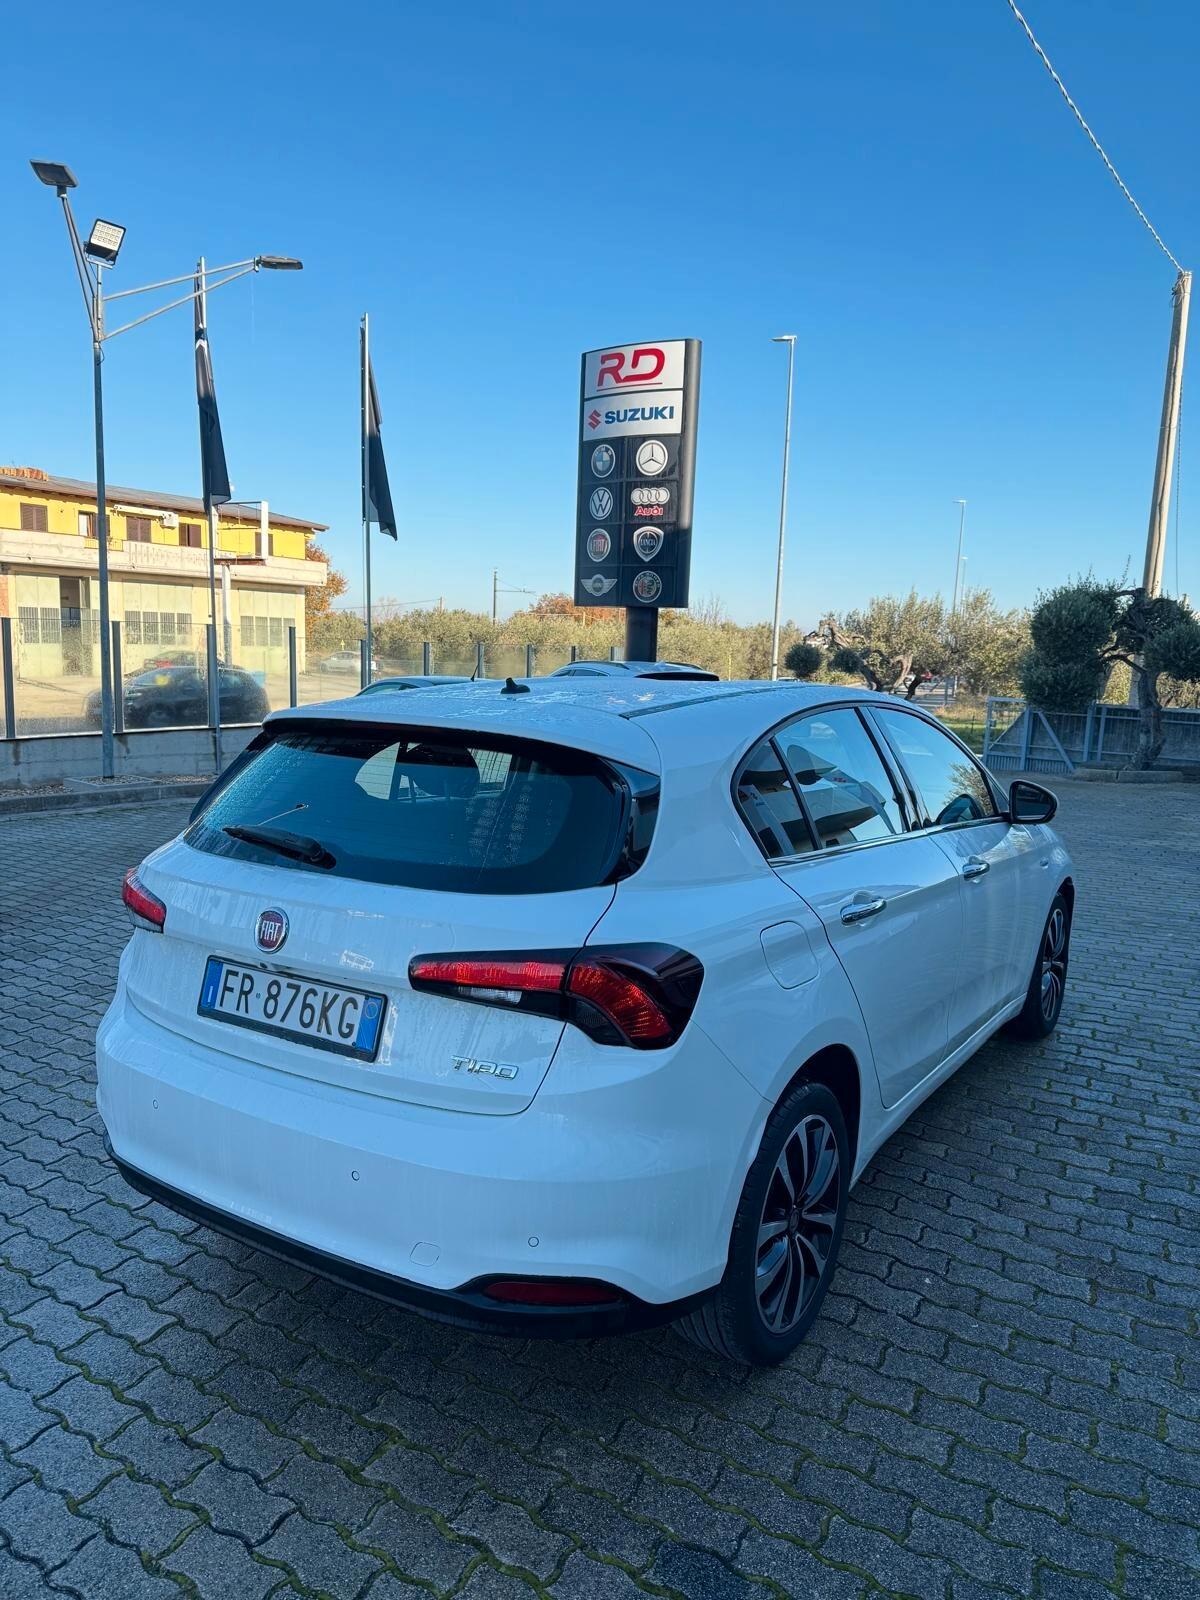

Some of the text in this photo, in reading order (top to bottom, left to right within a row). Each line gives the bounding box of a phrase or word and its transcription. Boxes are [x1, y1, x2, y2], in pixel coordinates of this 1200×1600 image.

[597, 348, 665, 386] RD
[604, 405, 674, 424] SUZUKI
[260, 920, 281, 941] FIAT
[450, 1055, 519, 1080] TIPO
